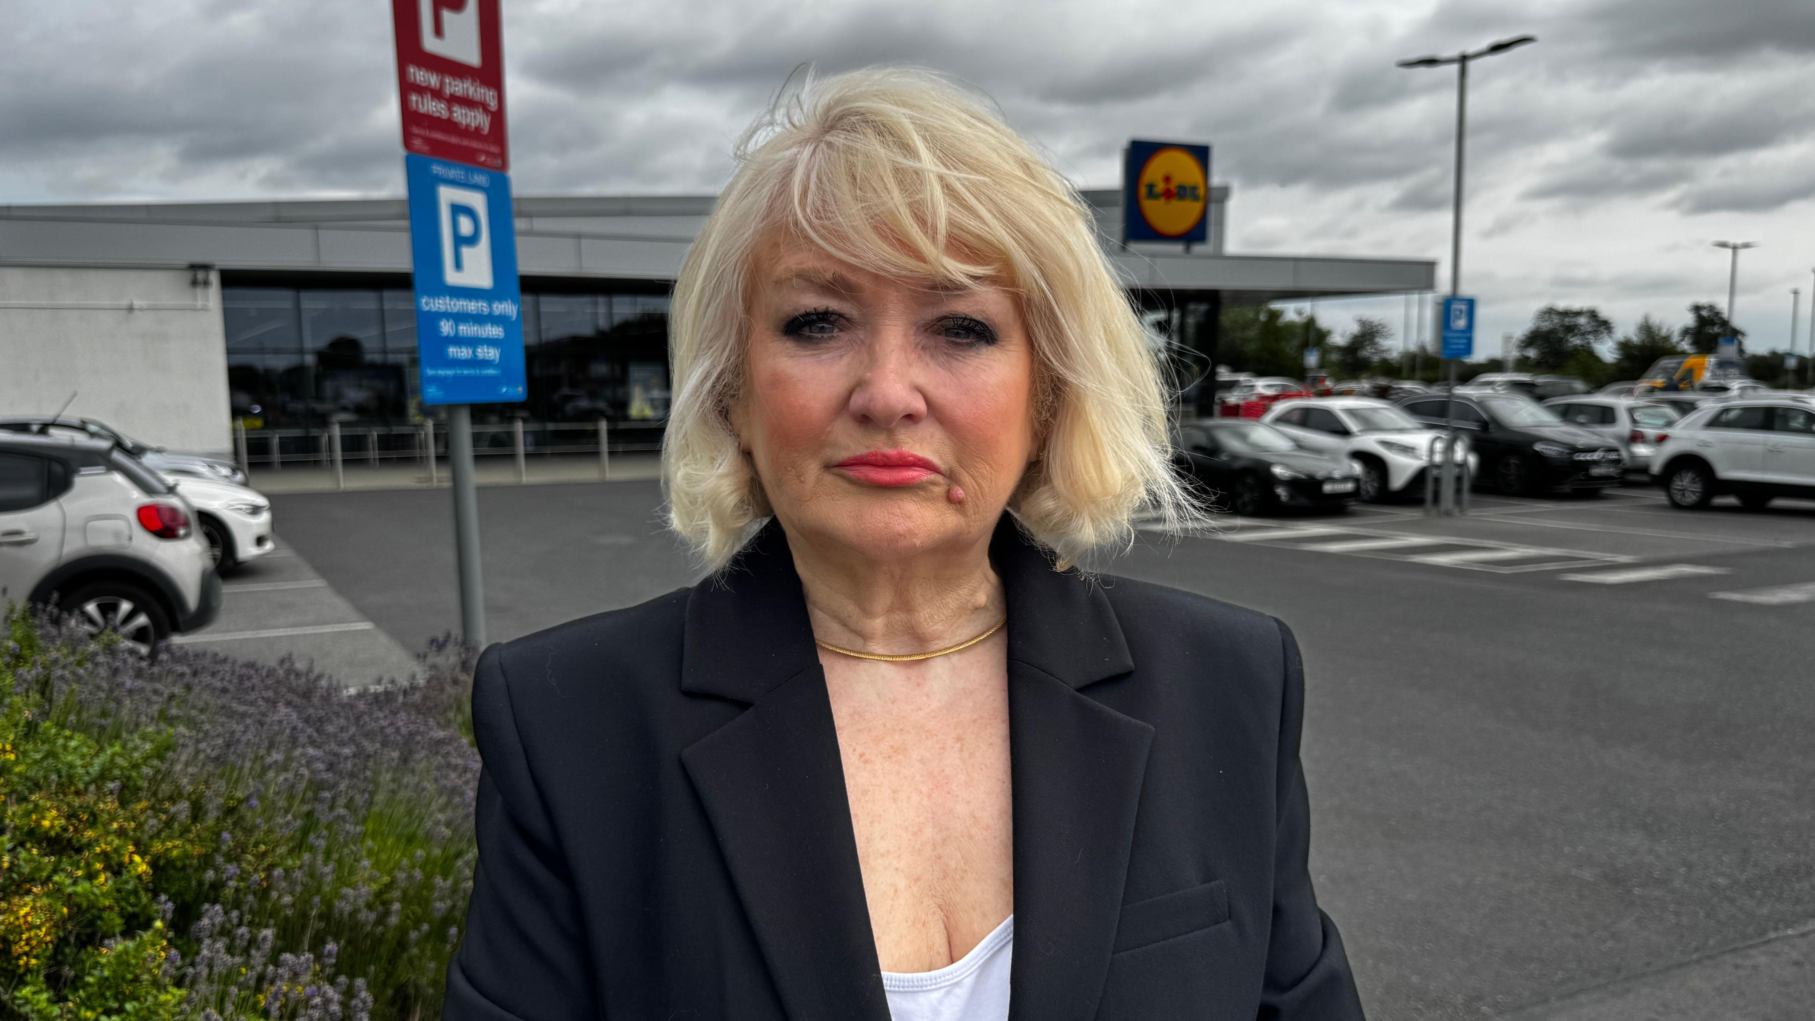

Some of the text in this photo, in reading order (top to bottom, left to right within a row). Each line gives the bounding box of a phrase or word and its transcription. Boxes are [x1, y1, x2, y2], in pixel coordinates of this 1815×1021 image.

[407, 64, 498, 111] new parking
[408, 91, 491, 135] rules apply
[450, 202, 482, 272] P
[422, 296, 518, 321] customers only
[440, 318, 505, 339] 90 minutes
[448, 344, 501, 365] max stay
